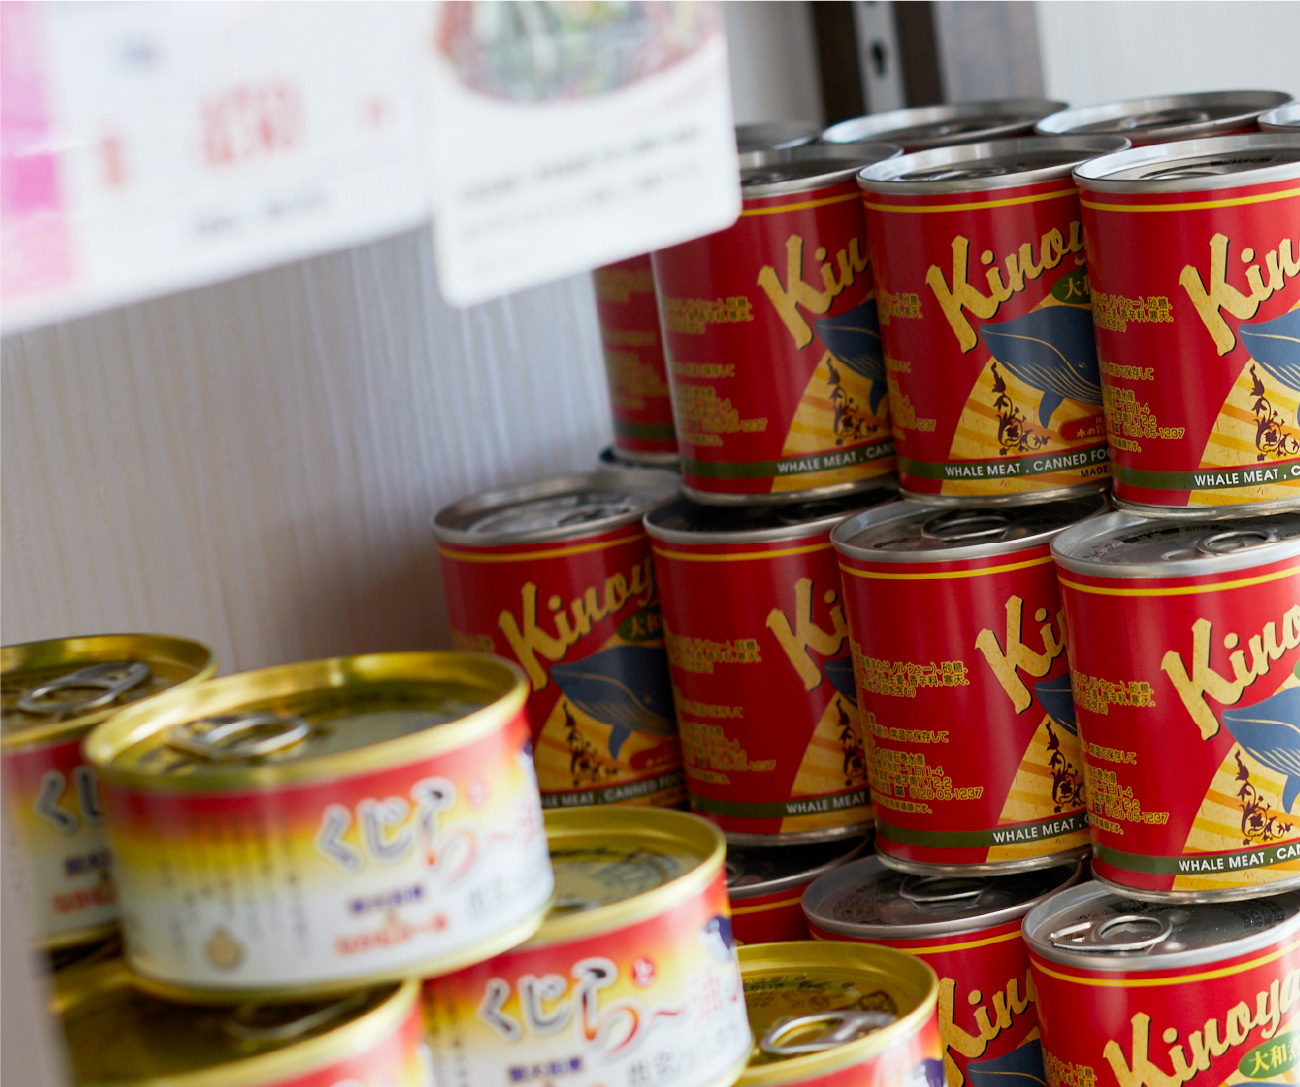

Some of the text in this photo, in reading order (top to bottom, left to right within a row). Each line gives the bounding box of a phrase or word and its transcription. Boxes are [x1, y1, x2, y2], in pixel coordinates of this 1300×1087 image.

[777, 458, 821, 474] WHALE
[824, 452, 857, 467] MEAT
[945, 461, 984, 477] WHALE
[986, 462, 1021, 475] MEAT
[1033, 453, 1088, 473] CANNED
[1194, 472, 1240, 487] WHALE
[1243, 468, 1279, 483] MEAT
[786, 797, 829, 815] WHALE
[833, 791, 866, 809] MEAT
[909, 786, 984, 801] 0120-05-1237
[993, 827, 1040, 845] WHALE
[1043, 820, 1075, 838] MEAT
[1178, 857, 1225, 872] WHALE
[1228, 851, 1265, 869] MEAT
